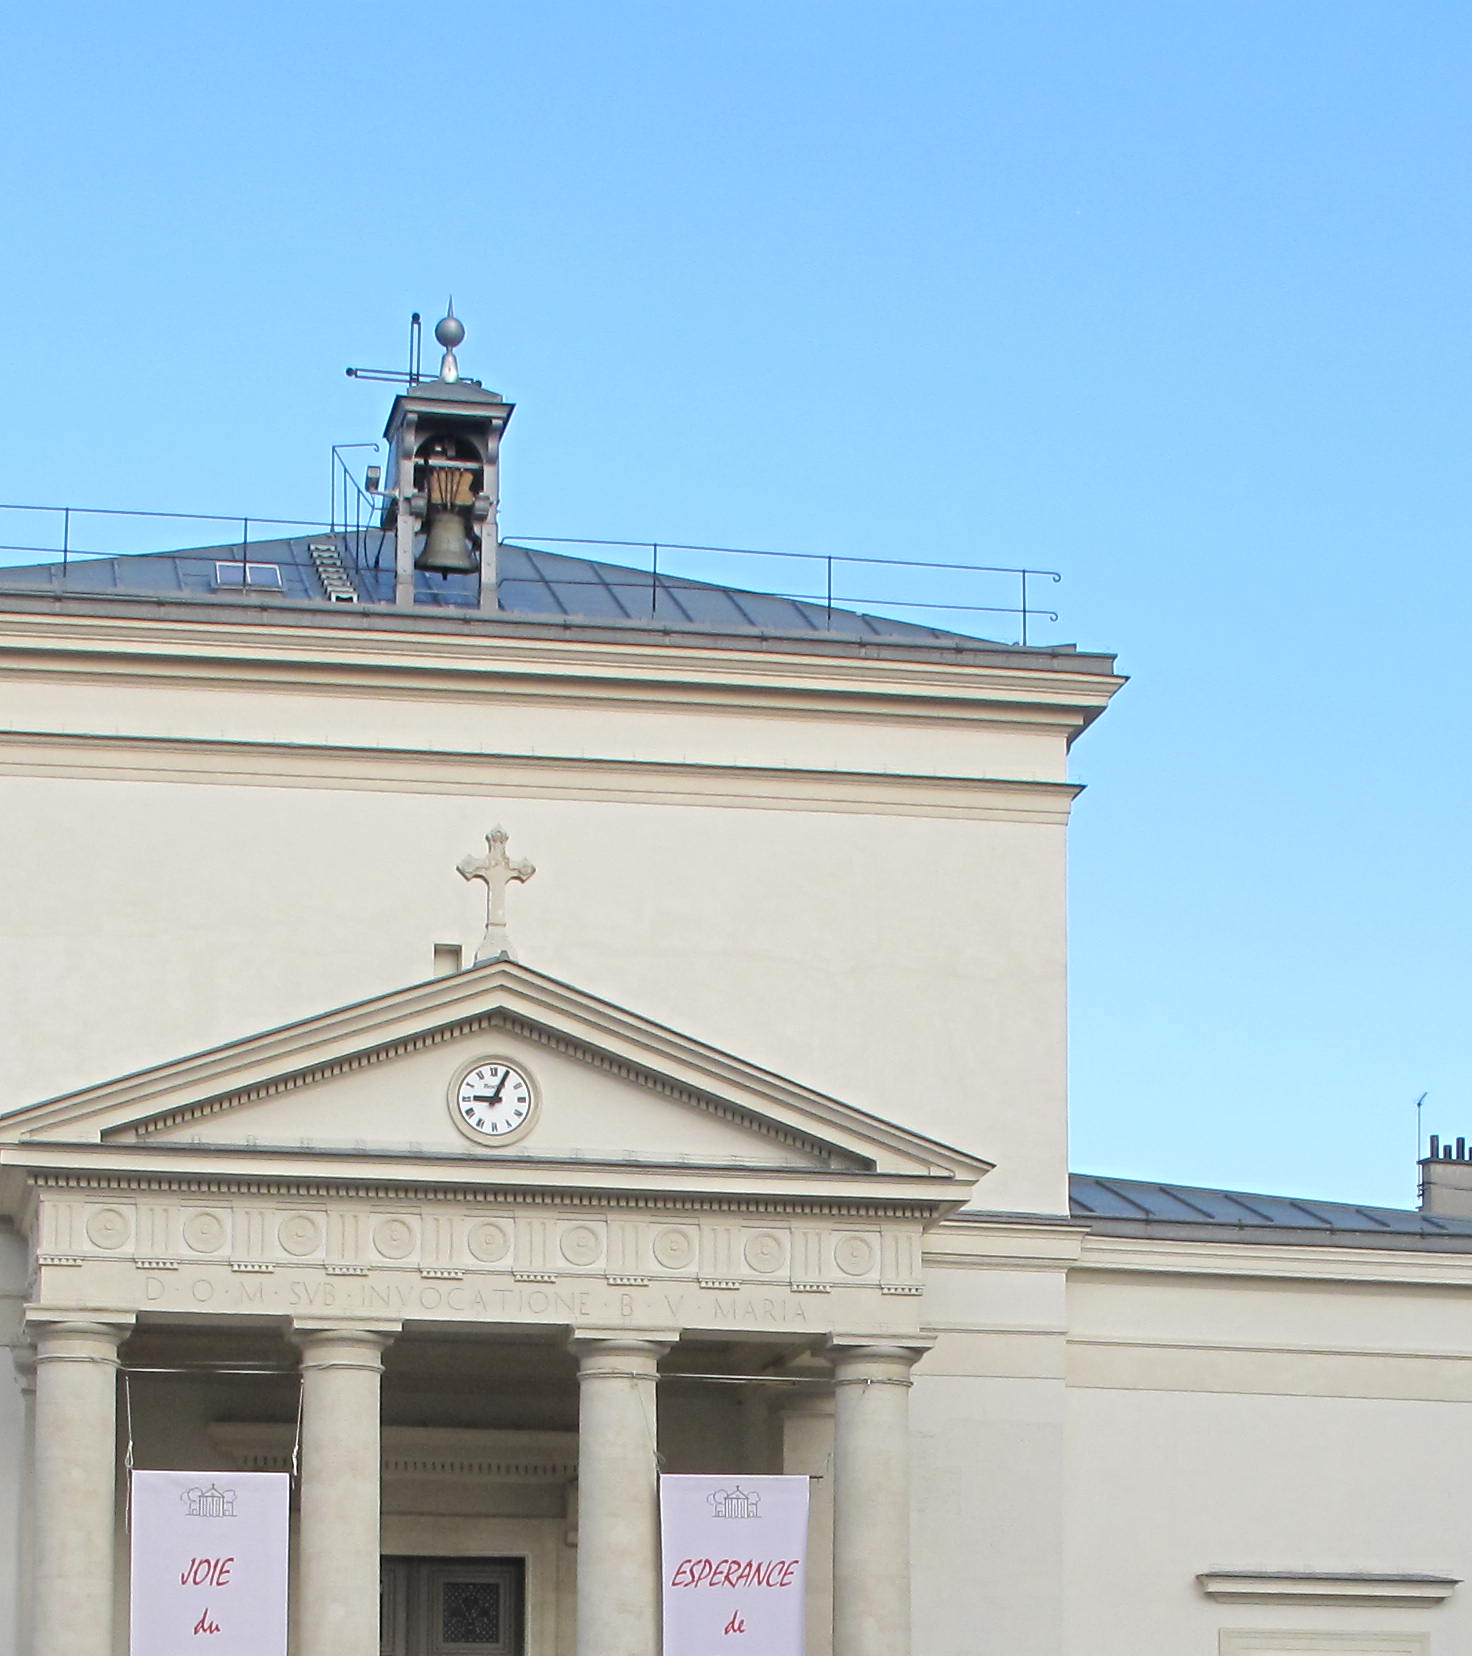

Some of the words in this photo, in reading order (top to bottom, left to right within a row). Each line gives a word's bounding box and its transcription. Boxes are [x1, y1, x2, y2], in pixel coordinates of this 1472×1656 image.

[145, 1276, 166, 1301] D
[191, 1278, 215, 1303] O
[239, 1281, 265, 1304] M
[288, 1281, 337, 1306] SVB
[361, 1284, 591, 1317] INVOCATIONE
[619, 1293, 634, 1318] B
[664, 1294, 684, 1318] V
[713, 1297, 807, 1322] MARIA
[180, 1557, 235, 1587] JOIE
[671, 1558, 800, 1589] ESPERANCE
[193, 1607, 221, 1635] du
[723, 1609, 746, 1635] de
